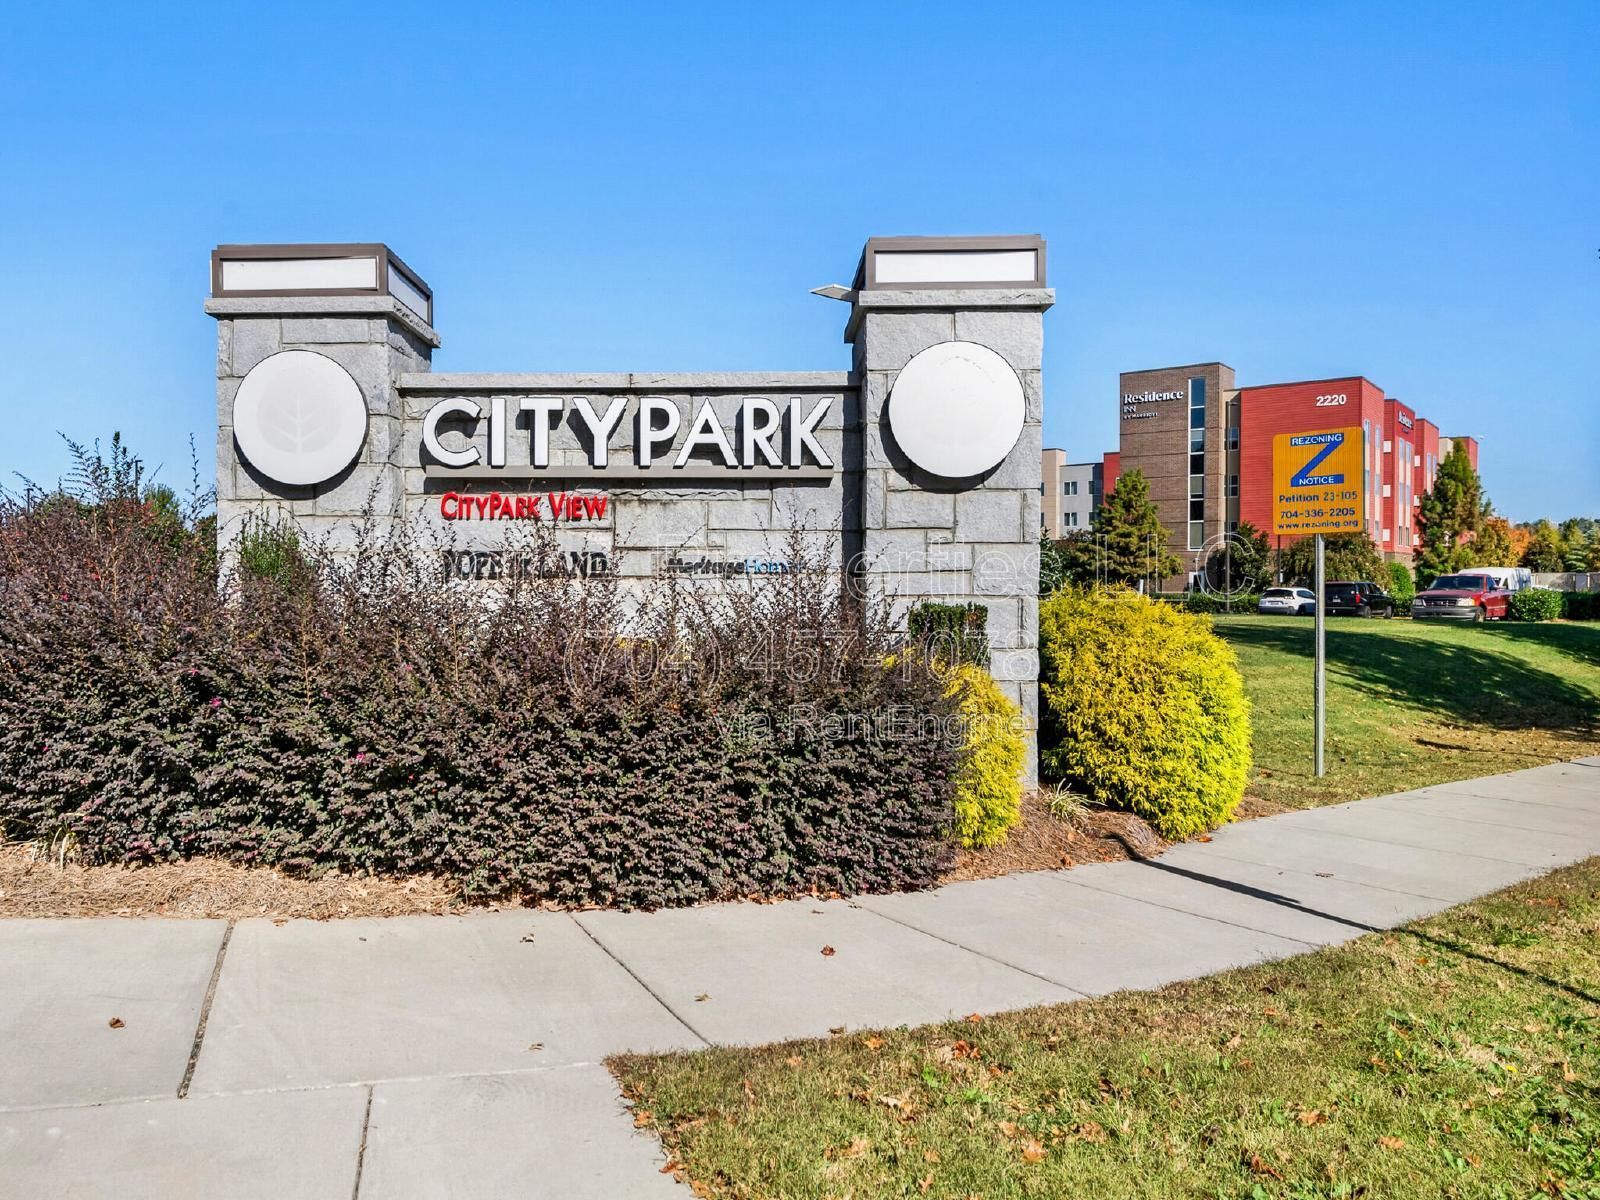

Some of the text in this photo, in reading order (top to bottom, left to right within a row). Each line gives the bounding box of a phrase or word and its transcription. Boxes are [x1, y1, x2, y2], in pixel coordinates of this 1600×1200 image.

[1124, 391, 1184, 404] Residence
[1316, 394, 1346, 407] 2220
[422, 397, 835, 468] CITYPARK
[1291, 434, 1342, 445] REZONING
[1299, 476, 1334, 485] NOTICE
[1279, 491, 1357, 503] Petition 23-105
[1280, 507, 1355, 519] 704-336-2205
[1278, 519, 1358, 530] www.rezoning.org
